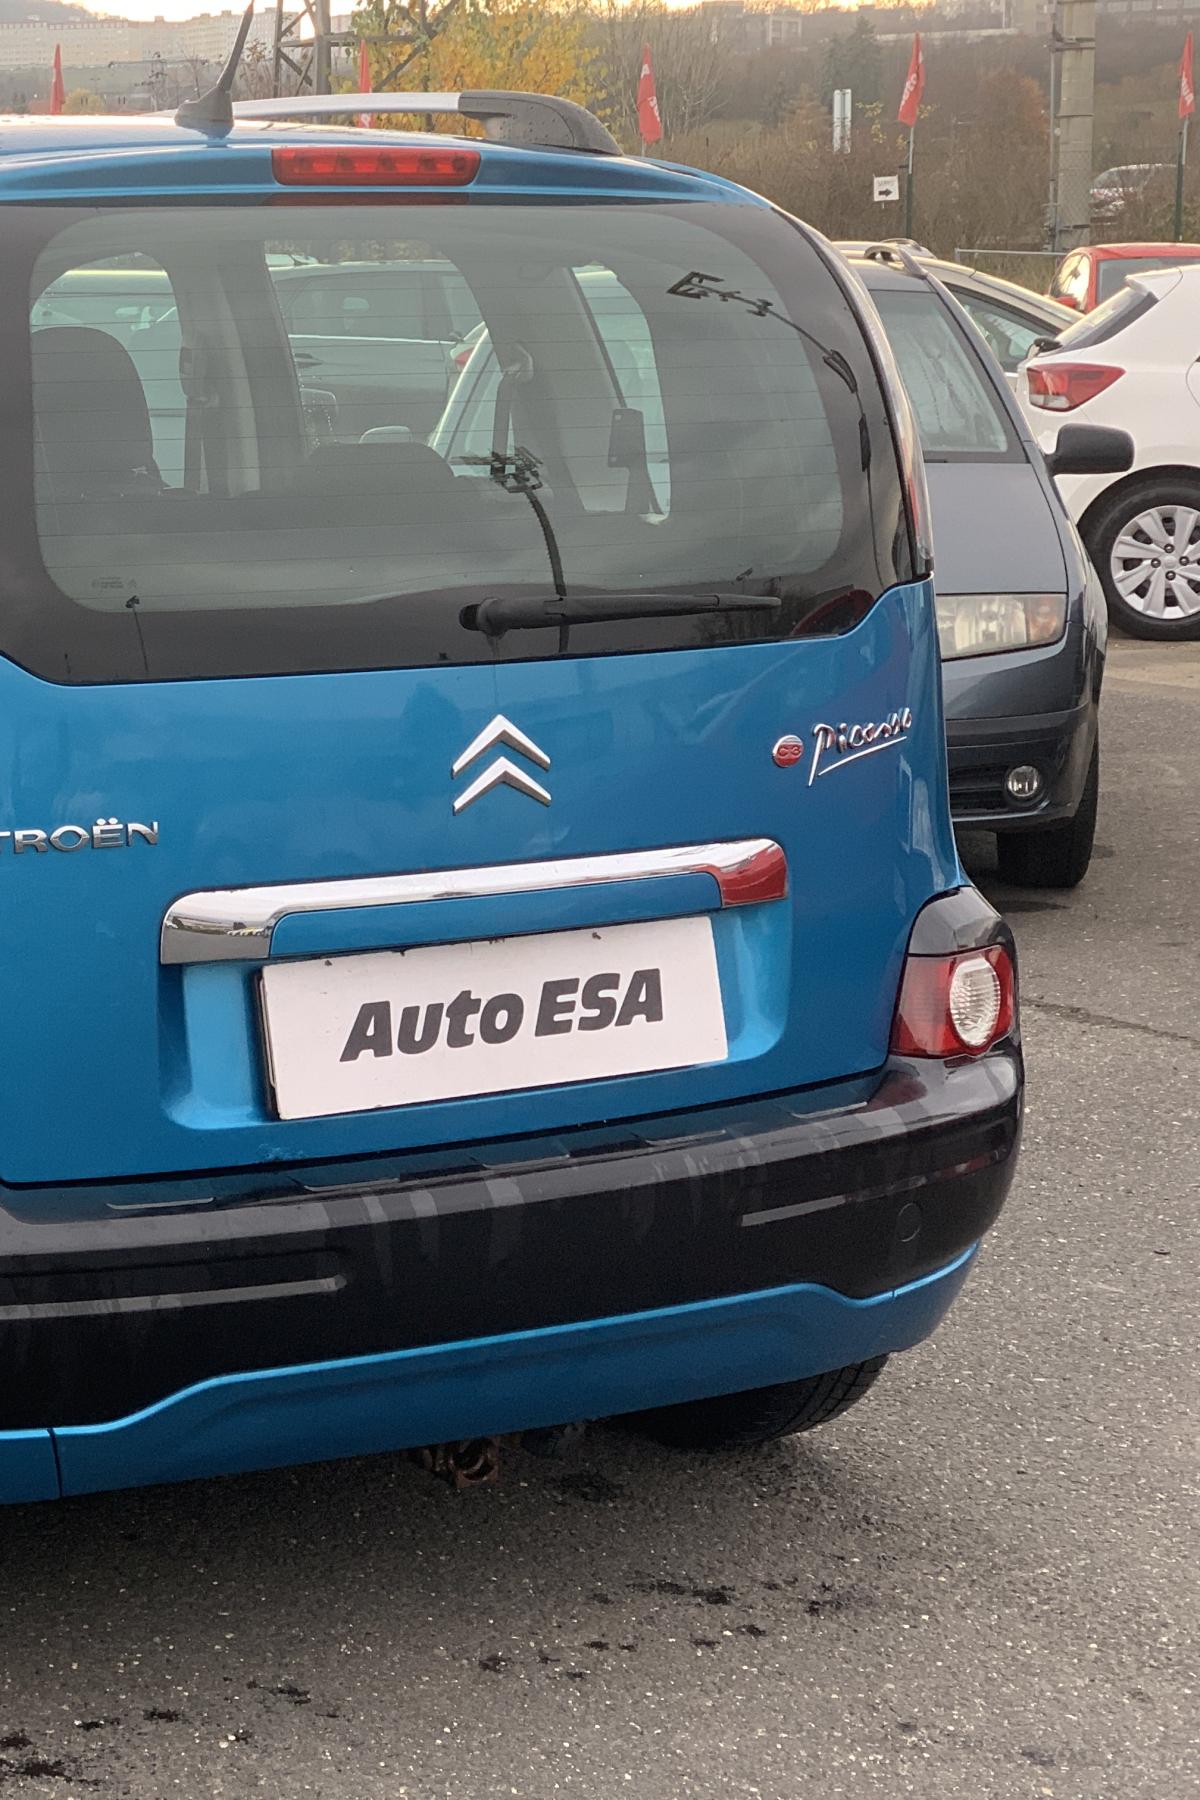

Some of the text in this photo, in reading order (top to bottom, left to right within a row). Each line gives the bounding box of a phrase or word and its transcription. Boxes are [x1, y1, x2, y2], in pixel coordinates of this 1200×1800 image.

[807, 707, 912, 786] Picasso
[339, 968, 664, 1063] Auto ESA
